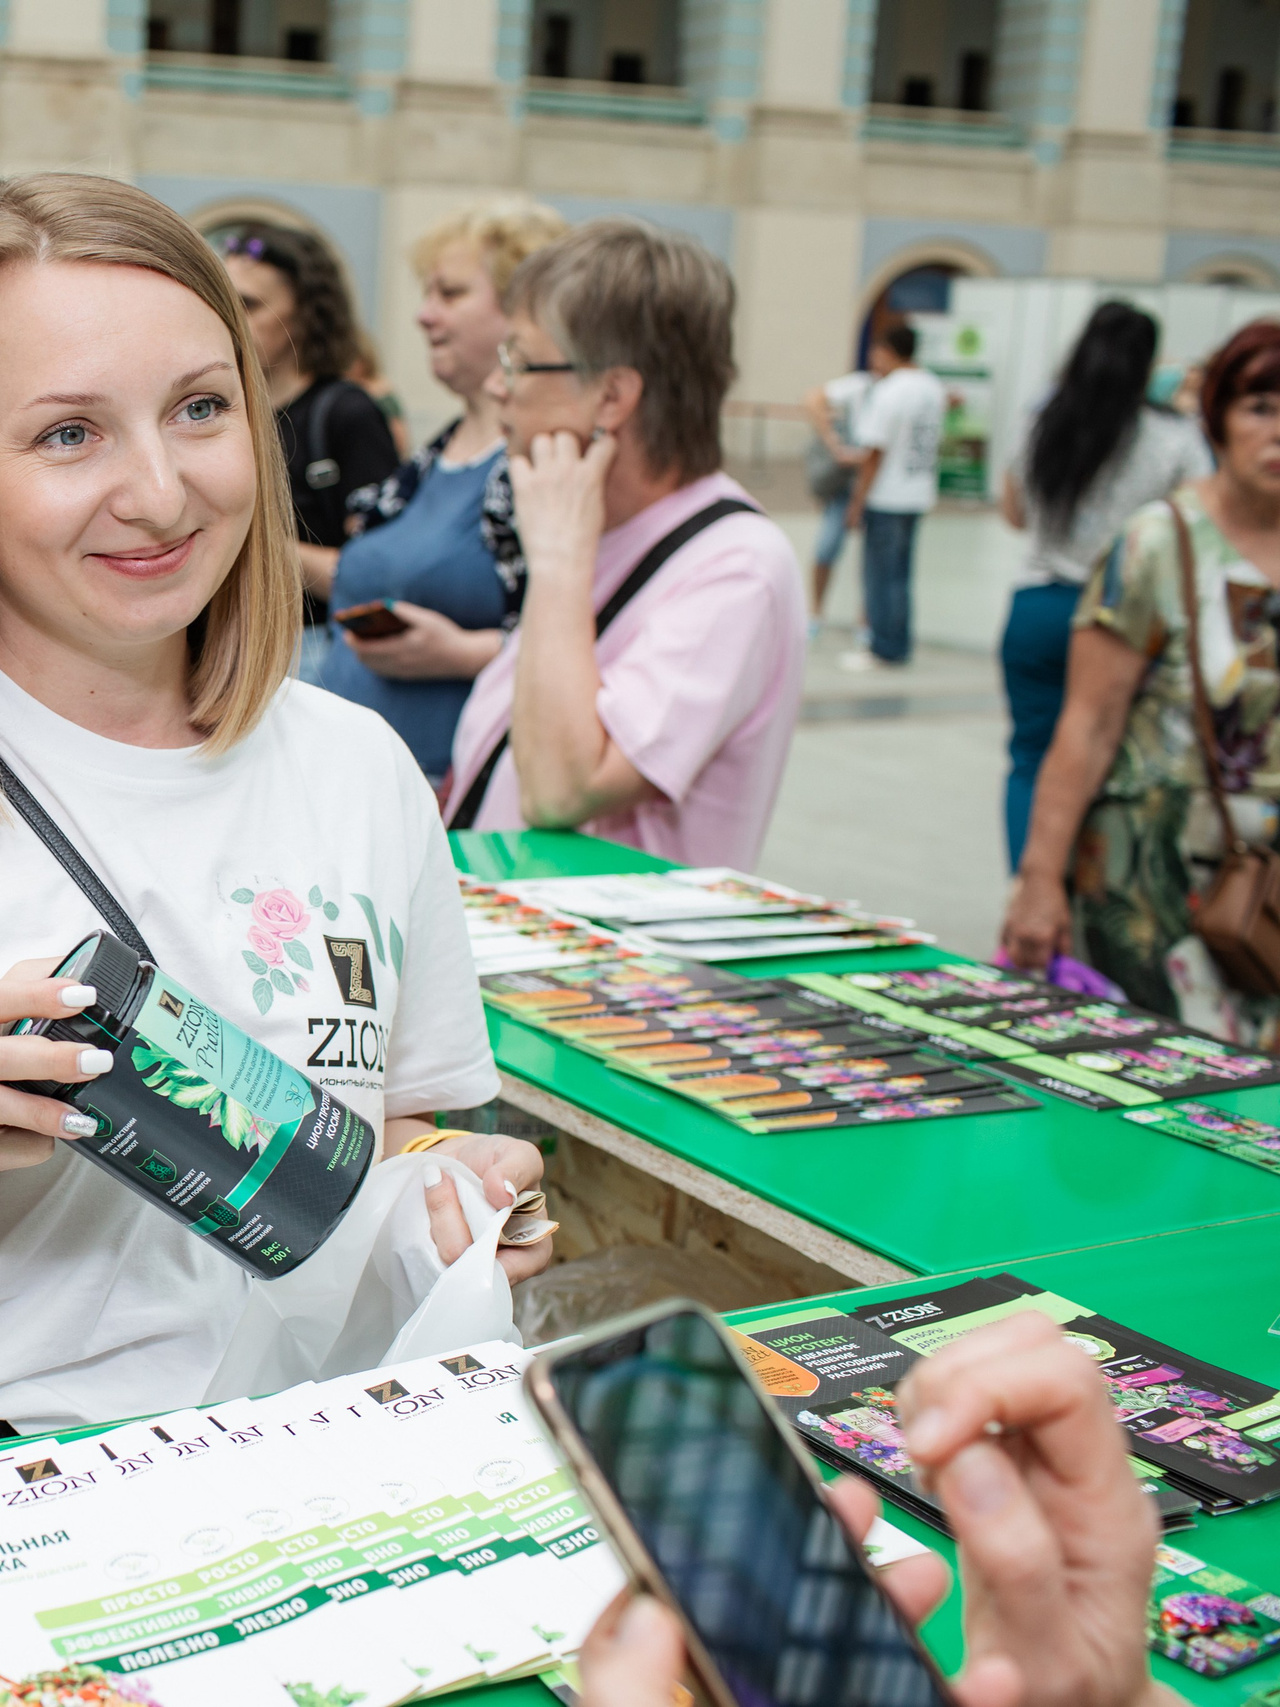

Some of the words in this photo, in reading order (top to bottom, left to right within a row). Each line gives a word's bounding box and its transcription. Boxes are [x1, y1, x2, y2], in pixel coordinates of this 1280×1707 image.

[176, 998, 205, 1048] ZION
[306, 1118, 325, 1150] ЦИОН
[325, 1107, 341, 1140] КОСМО
[326, 1133, 347, 1171] ТЕХНОЛОГИЯ
[165, 1168, 197, 1197] СПОСОБСТВУЕТ
[228, 1214, 262, 1242] ПРОФИЛАКТИКА
[261, 1241, 281, 1257] Вес:
[269, 1250, 287, 1265] 700
[284, 1246, 292, 1254] г
[882, 1301, 942, 1322] ZION
[767, 1332, 816, 1349] ЦИОН
[780, 1335, 850, 1356] ПРОТЕКТ
[902, 1328, 945, 1343] НАБОРЫ
[793, 1342, 861, 1362] ИДЕАЛЬНОЕ
[805, 1352, 859, 1368] РЕШЕНИЕ
[816, 1361, 840, 1375] ДЛЯ
[838, 1350, 905, 1370] ПОДКОРМКИ
[826, 1362, 889, 1381] РАСТЕНИЙ!
[1, 1471, 97, 1506] ZION
[100, 1581, 182, 1614] ПРОСТО
[61, 1606, 201, 1653] ЭФФЕКТИВНО
[118, 1631, 221, 1671] ПОЛЕЗНО
